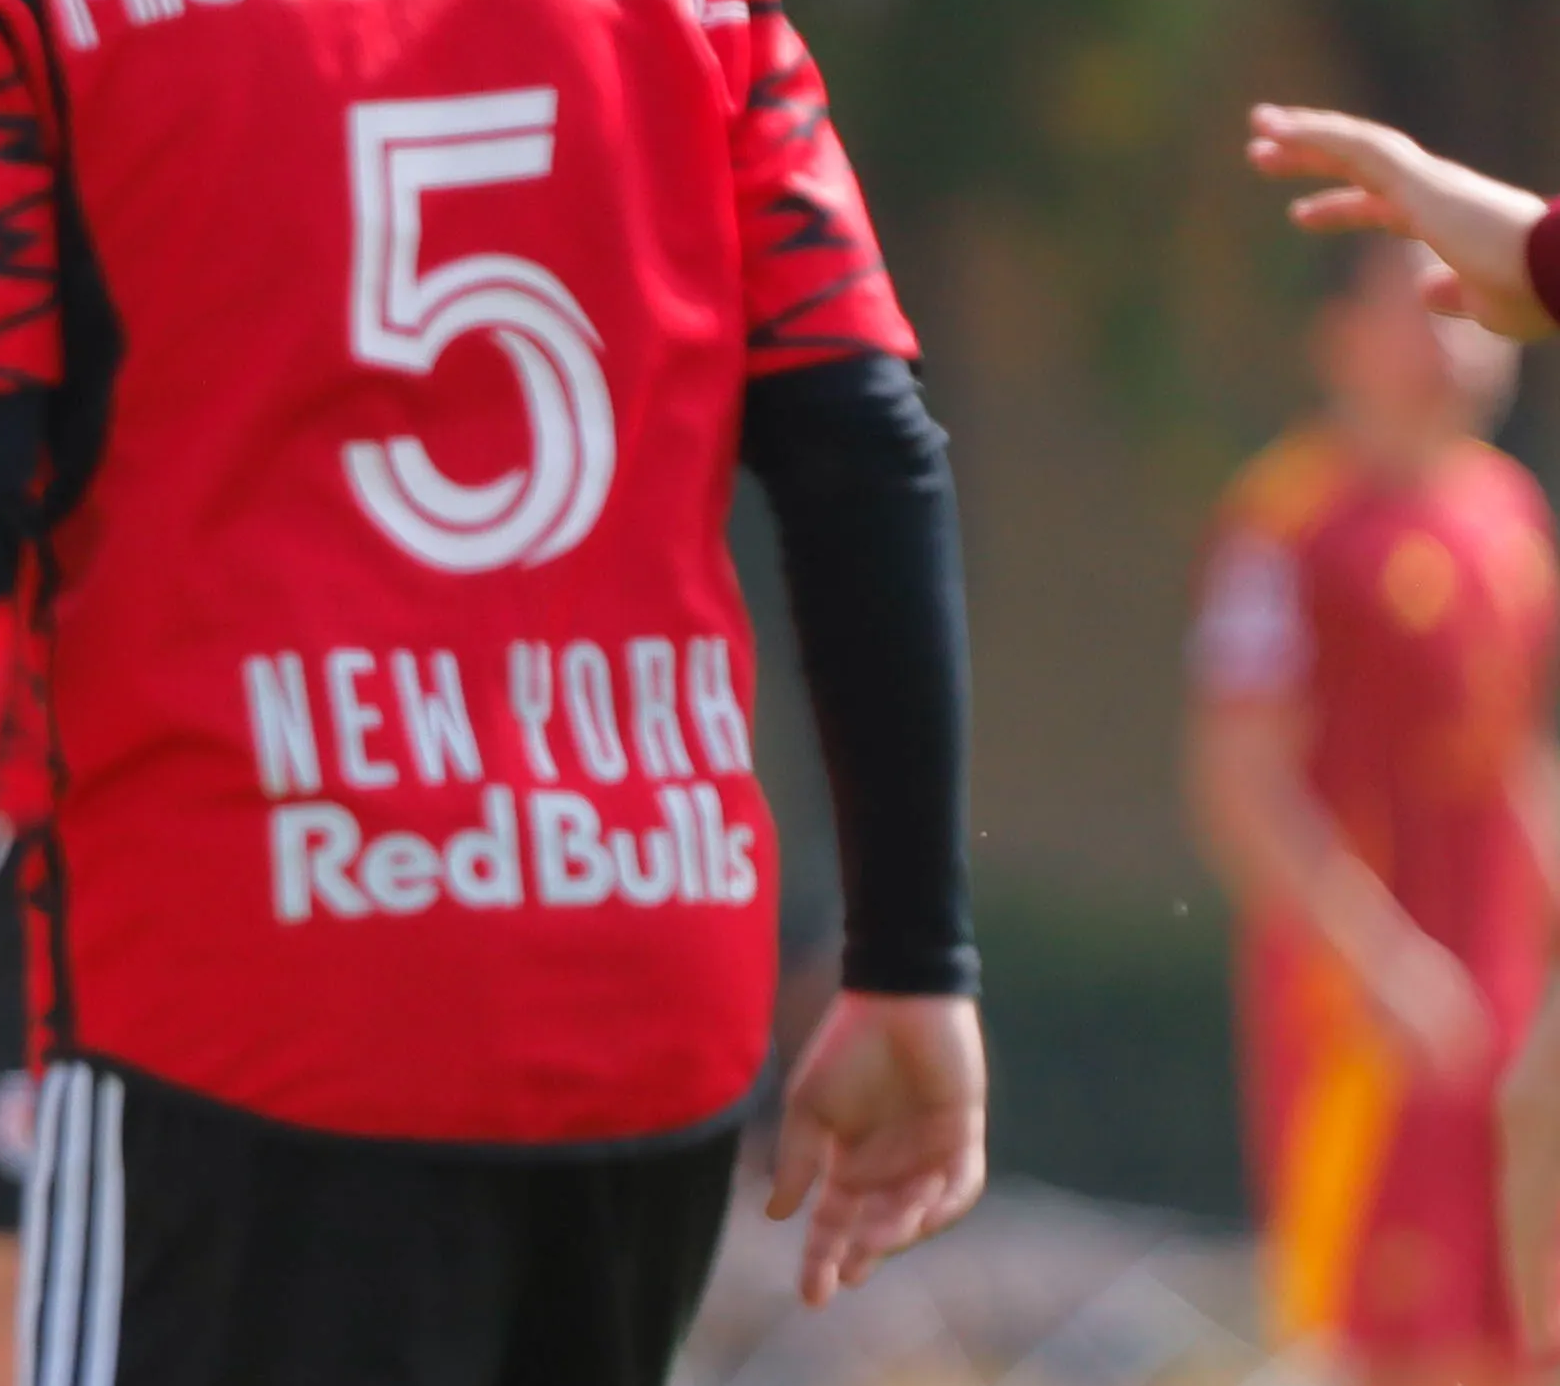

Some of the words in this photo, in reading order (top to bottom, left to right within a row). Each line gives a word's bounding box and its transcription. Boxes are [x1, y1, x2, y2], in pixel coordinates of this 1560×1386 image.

[344, 85, 617, 573] 5
[243, 647, 483, 796] NEW
[508, 635, 752, 783] YORK
